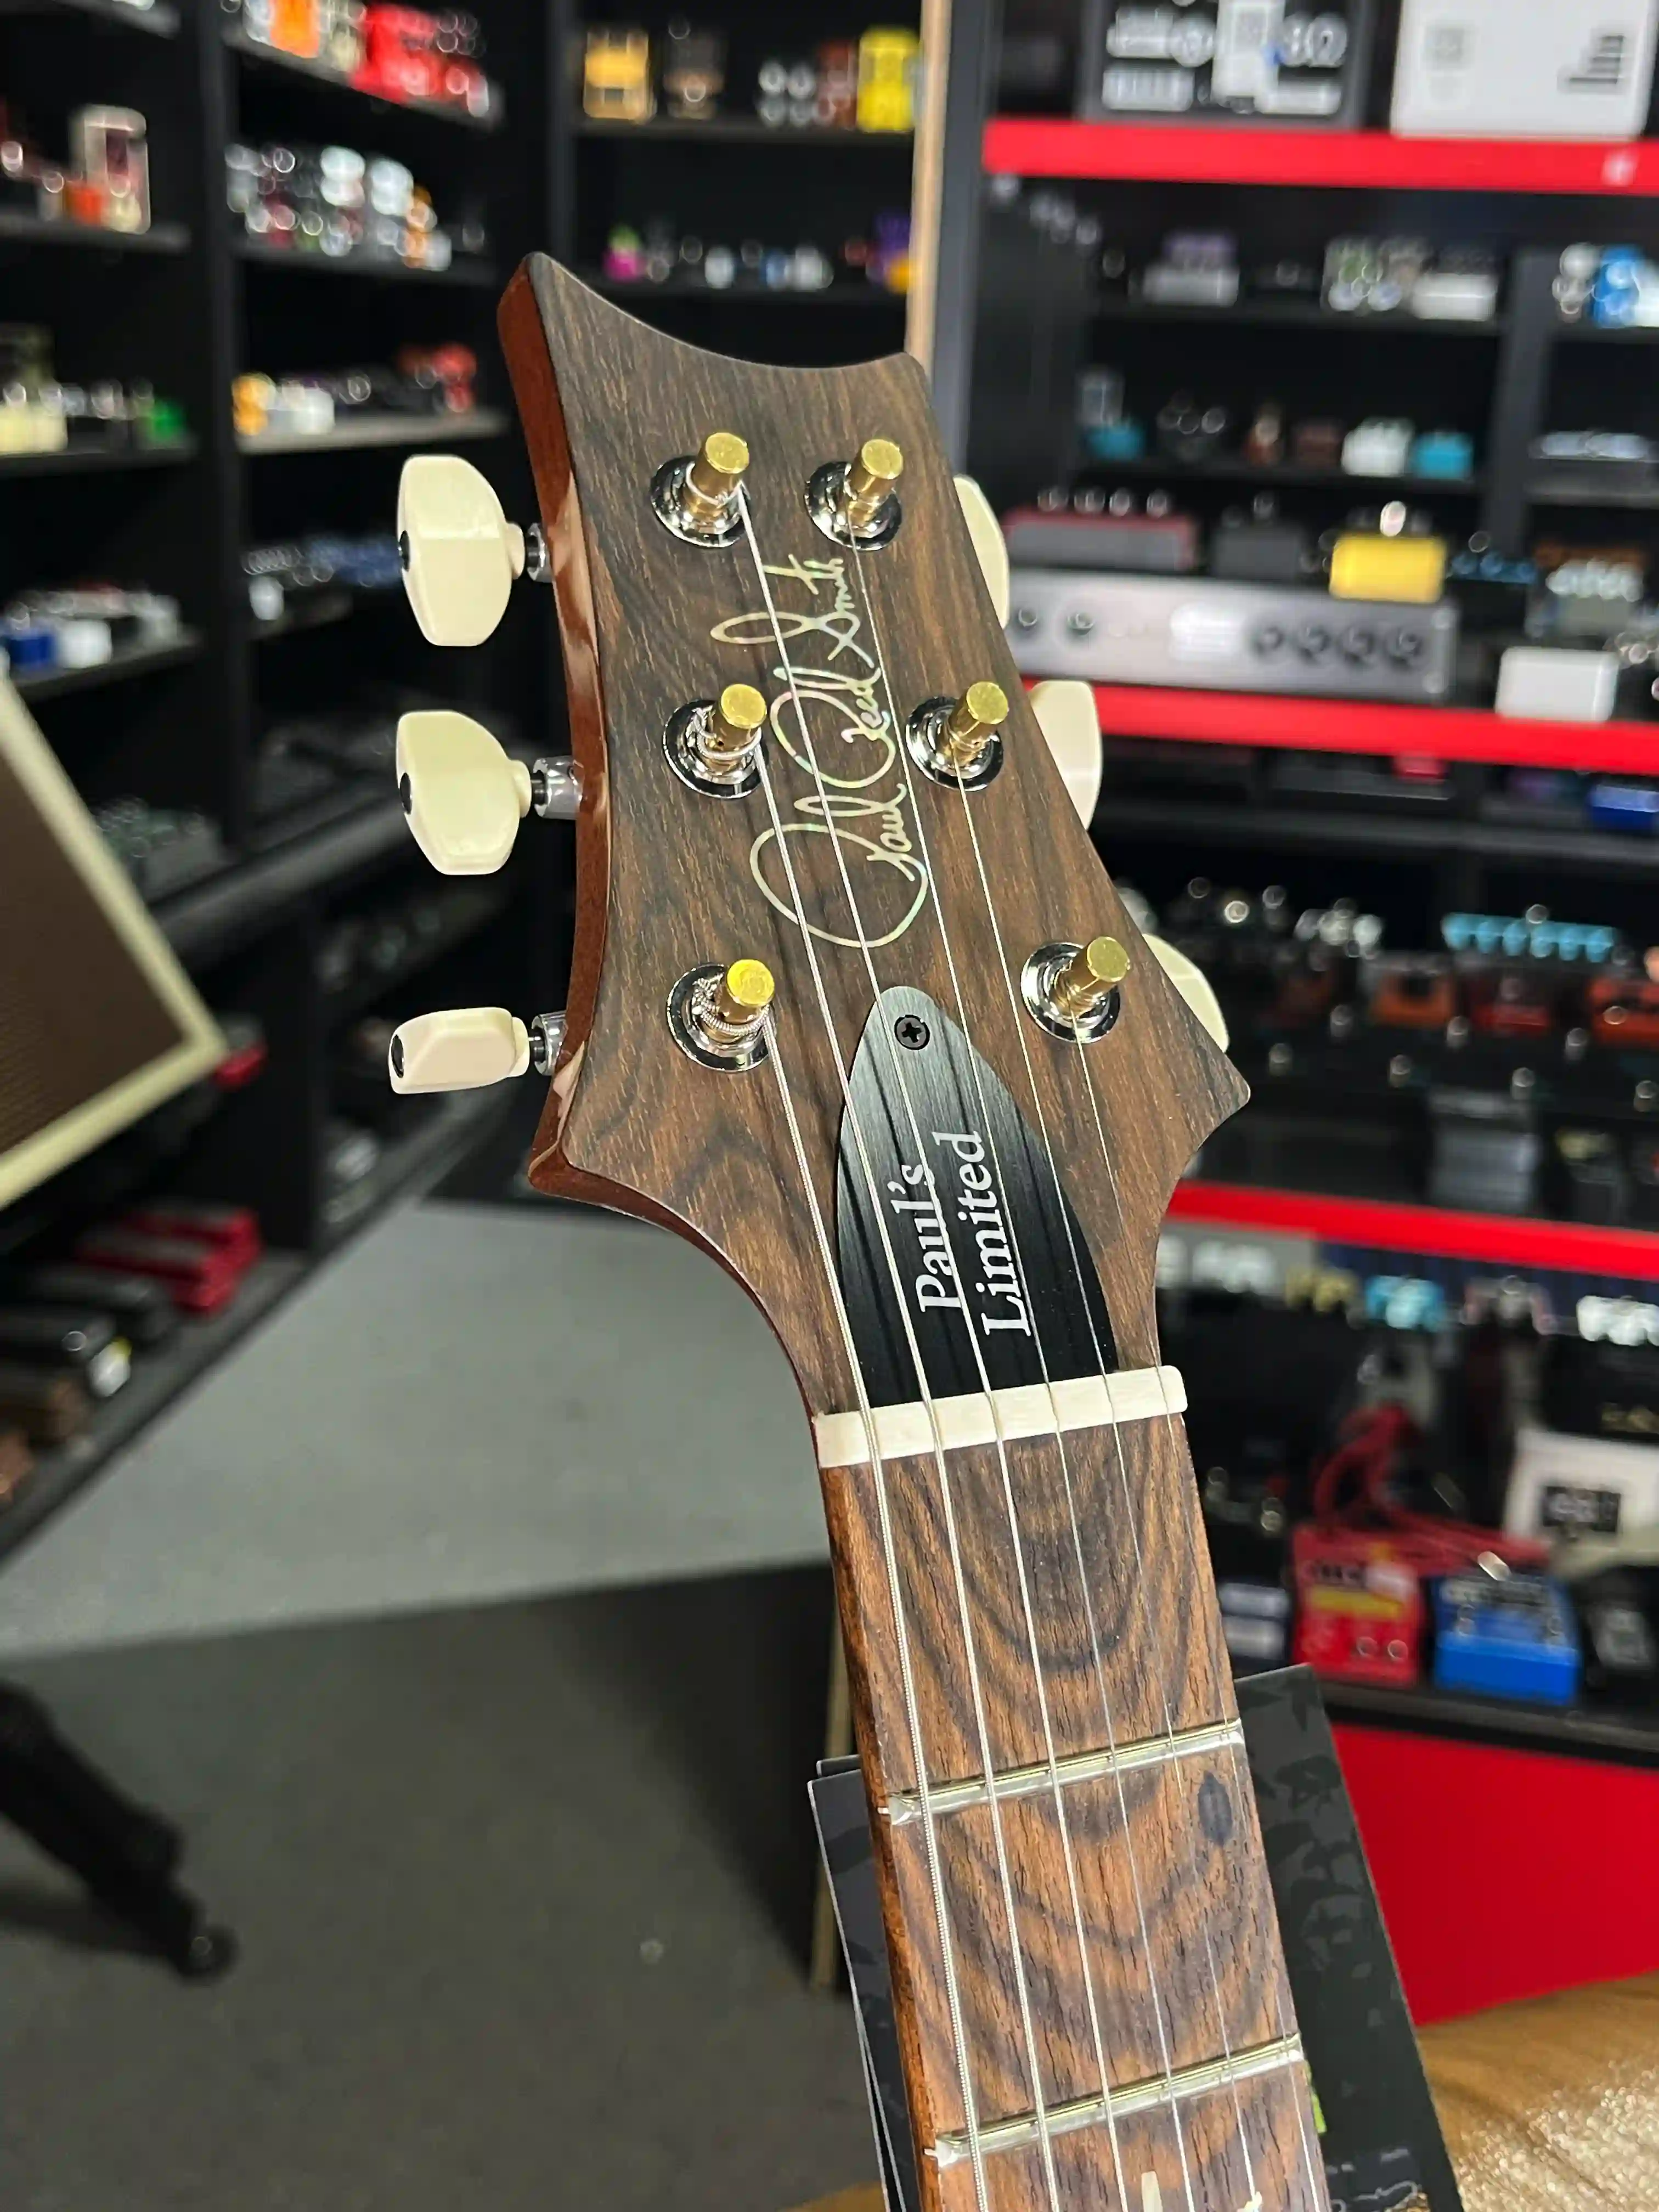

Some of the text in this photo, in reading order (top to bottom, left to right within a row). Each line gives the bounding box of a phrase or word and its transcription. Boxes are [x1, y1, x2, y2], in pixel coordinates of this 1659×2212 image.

[710, 554, 929, 948] Paul Reed Smith
[887, 1164, 962, 1312] Paul's
[932, 1130, 1031, 1336] Limited
